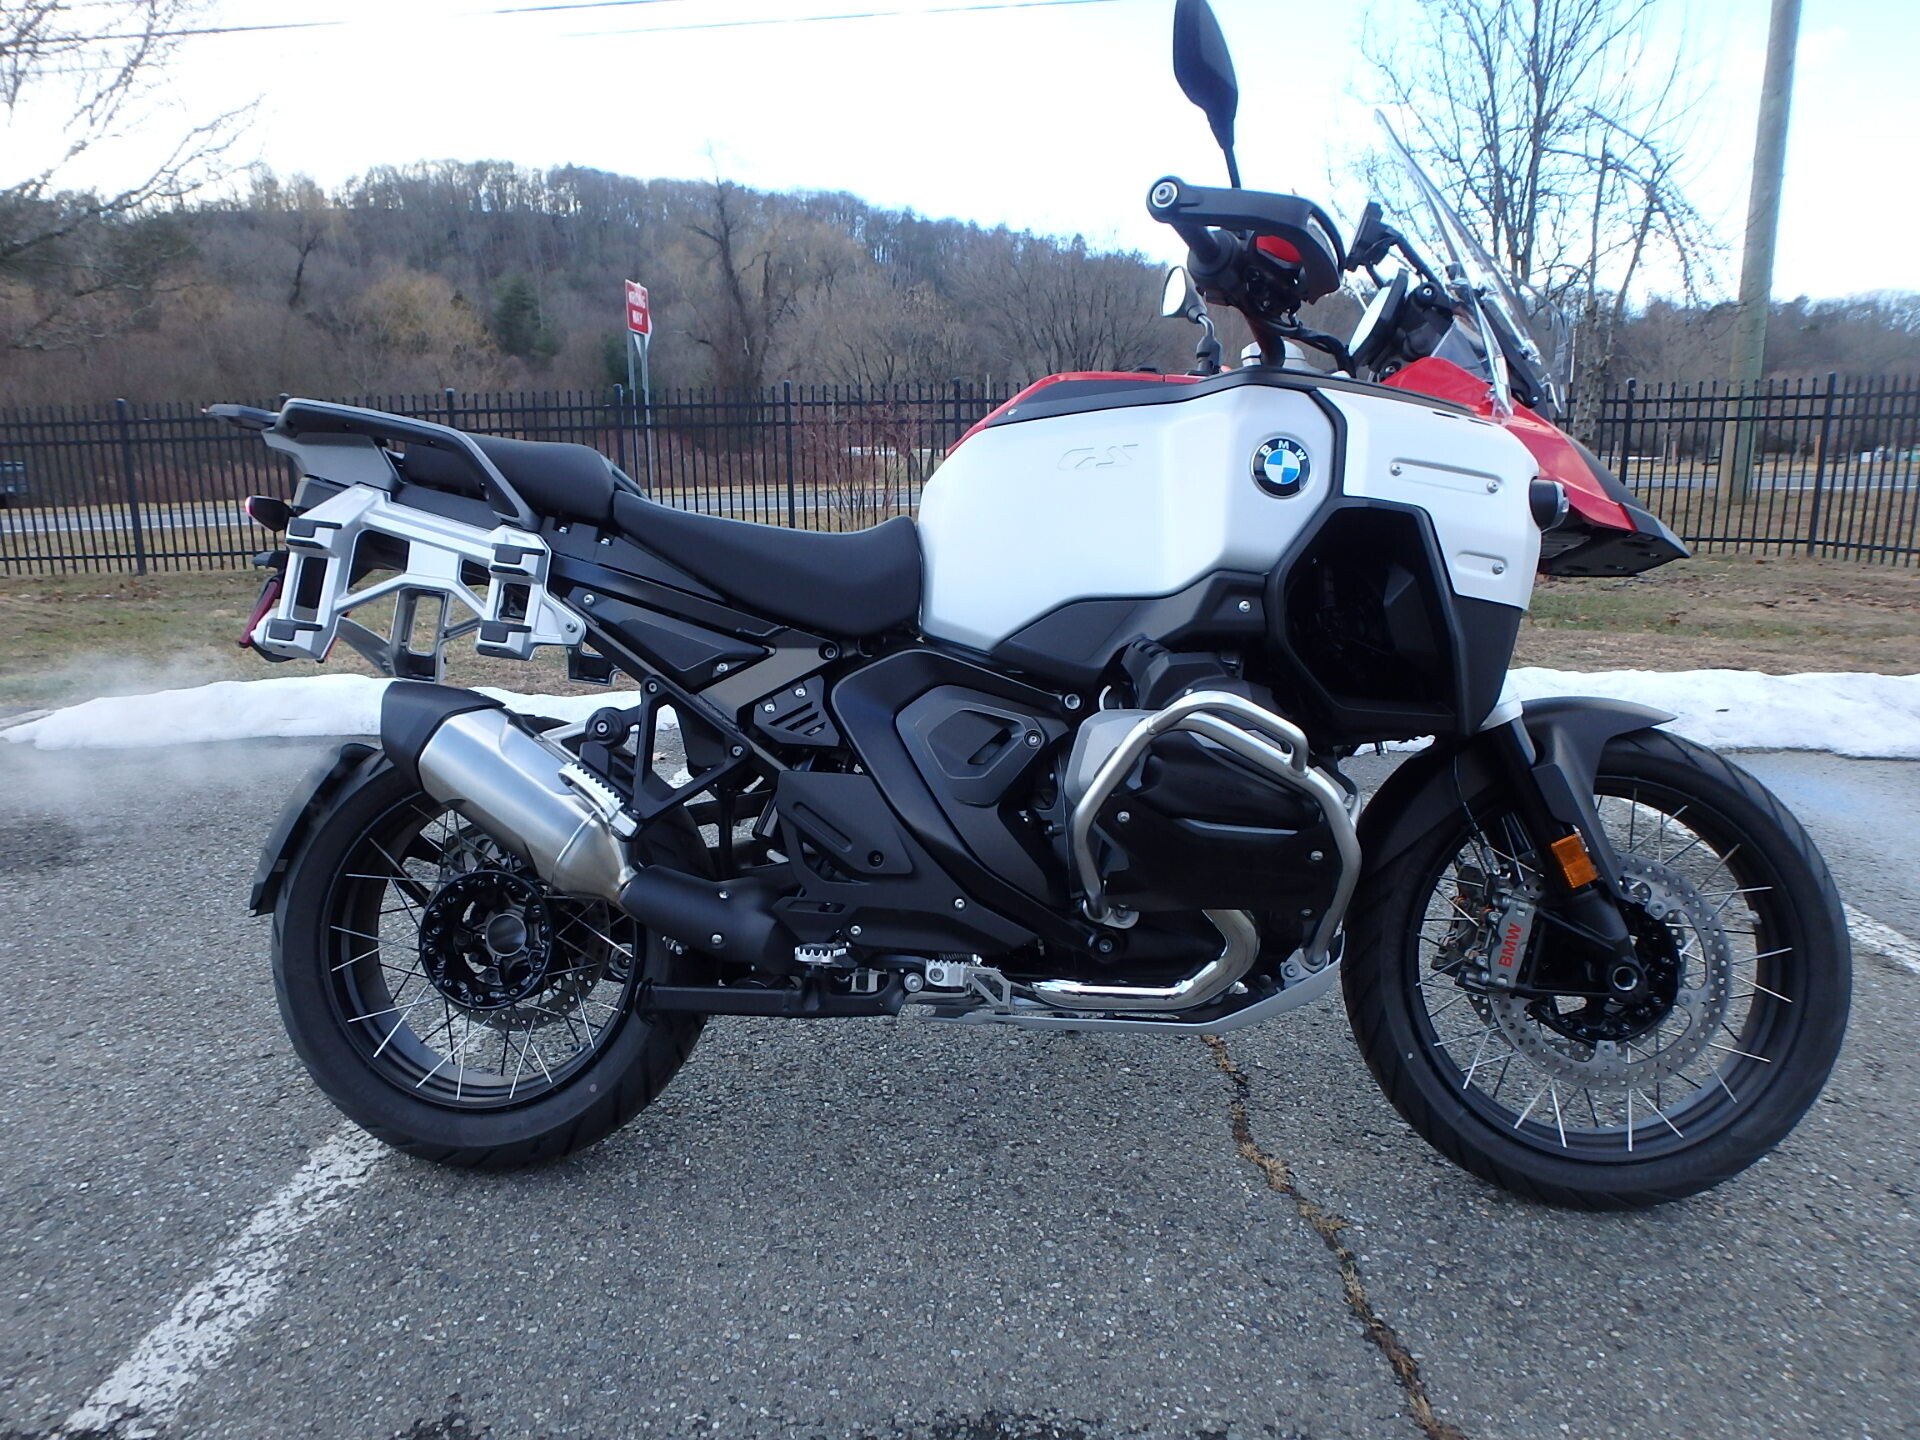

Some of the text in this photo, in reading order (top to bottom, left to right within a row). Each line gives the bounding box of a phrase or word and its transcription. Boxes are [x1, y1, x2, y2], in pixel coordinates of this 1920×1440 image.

[1057, 443, 1139, 471] GS
[1259, 440, 1307, 461] BMW
[1498, 922, 1521, 968] BMW
